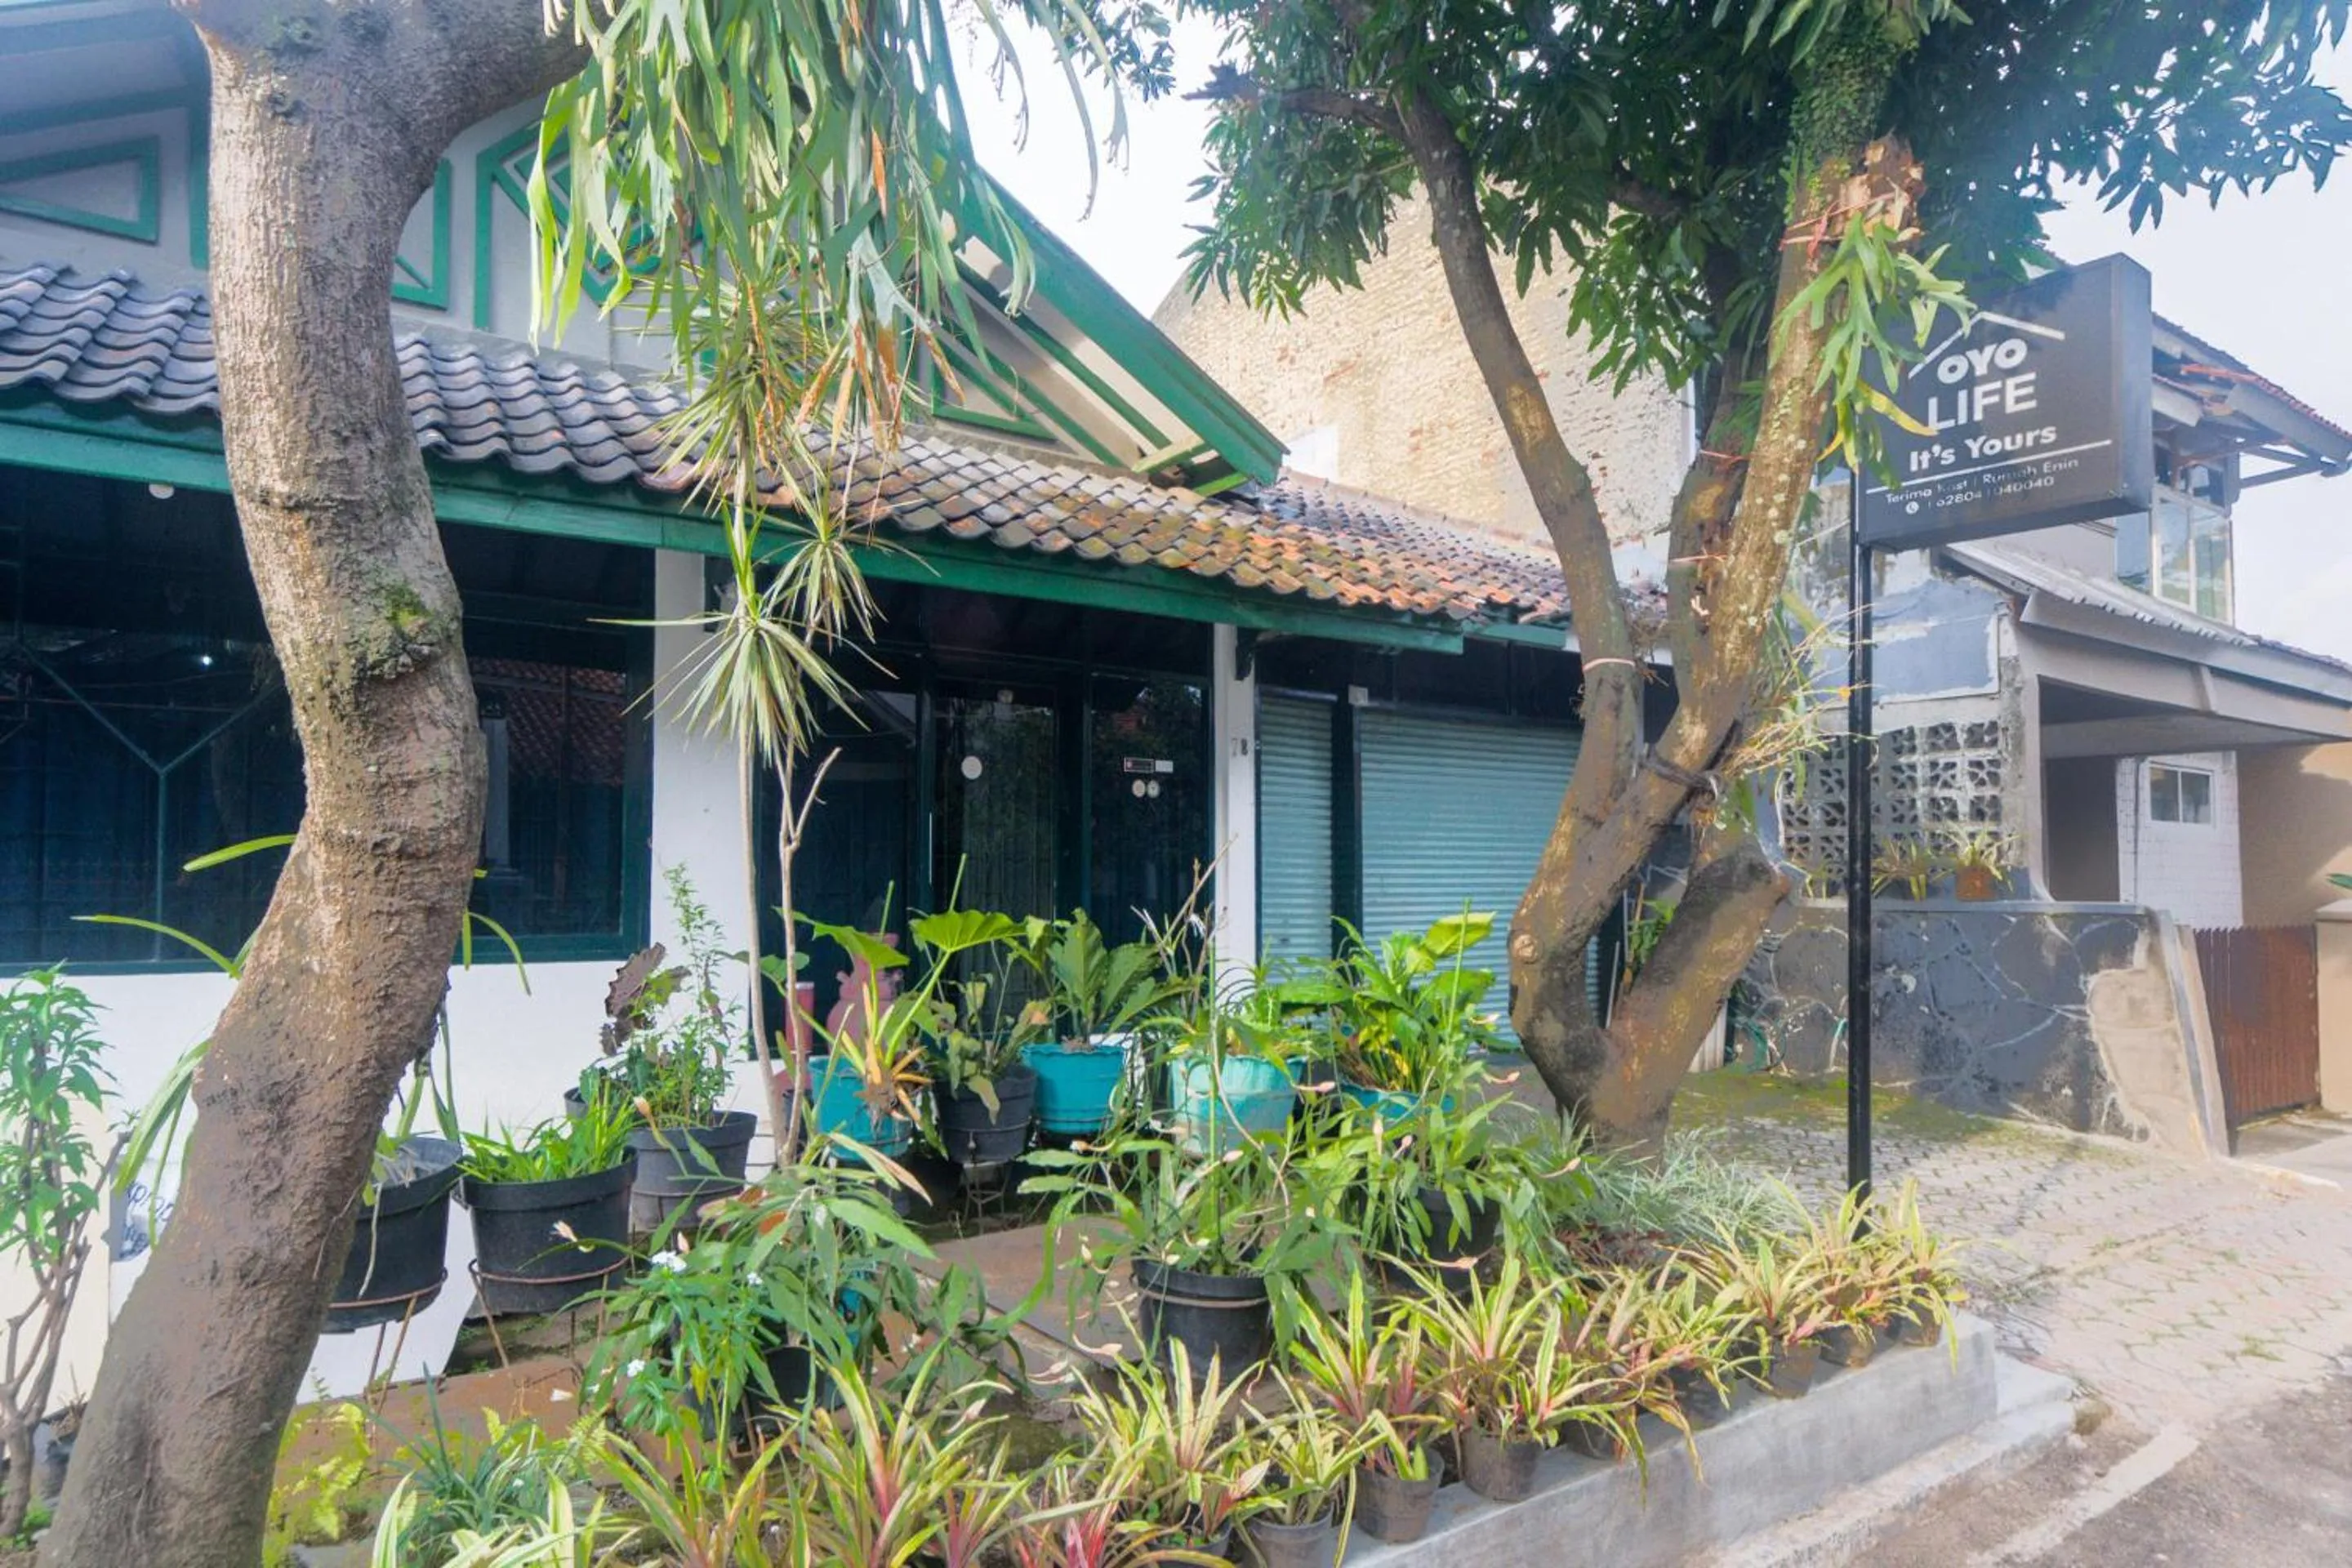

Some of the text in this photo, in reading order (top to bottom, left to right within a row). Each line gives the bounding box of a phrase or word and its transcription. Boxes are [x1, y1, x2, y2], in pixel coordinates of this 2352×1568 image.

[1937, 338, 2028, 384] OYO
[1928, 372, 2038, 430] LIFE
[1965, 426, 2056, 458] Yours
